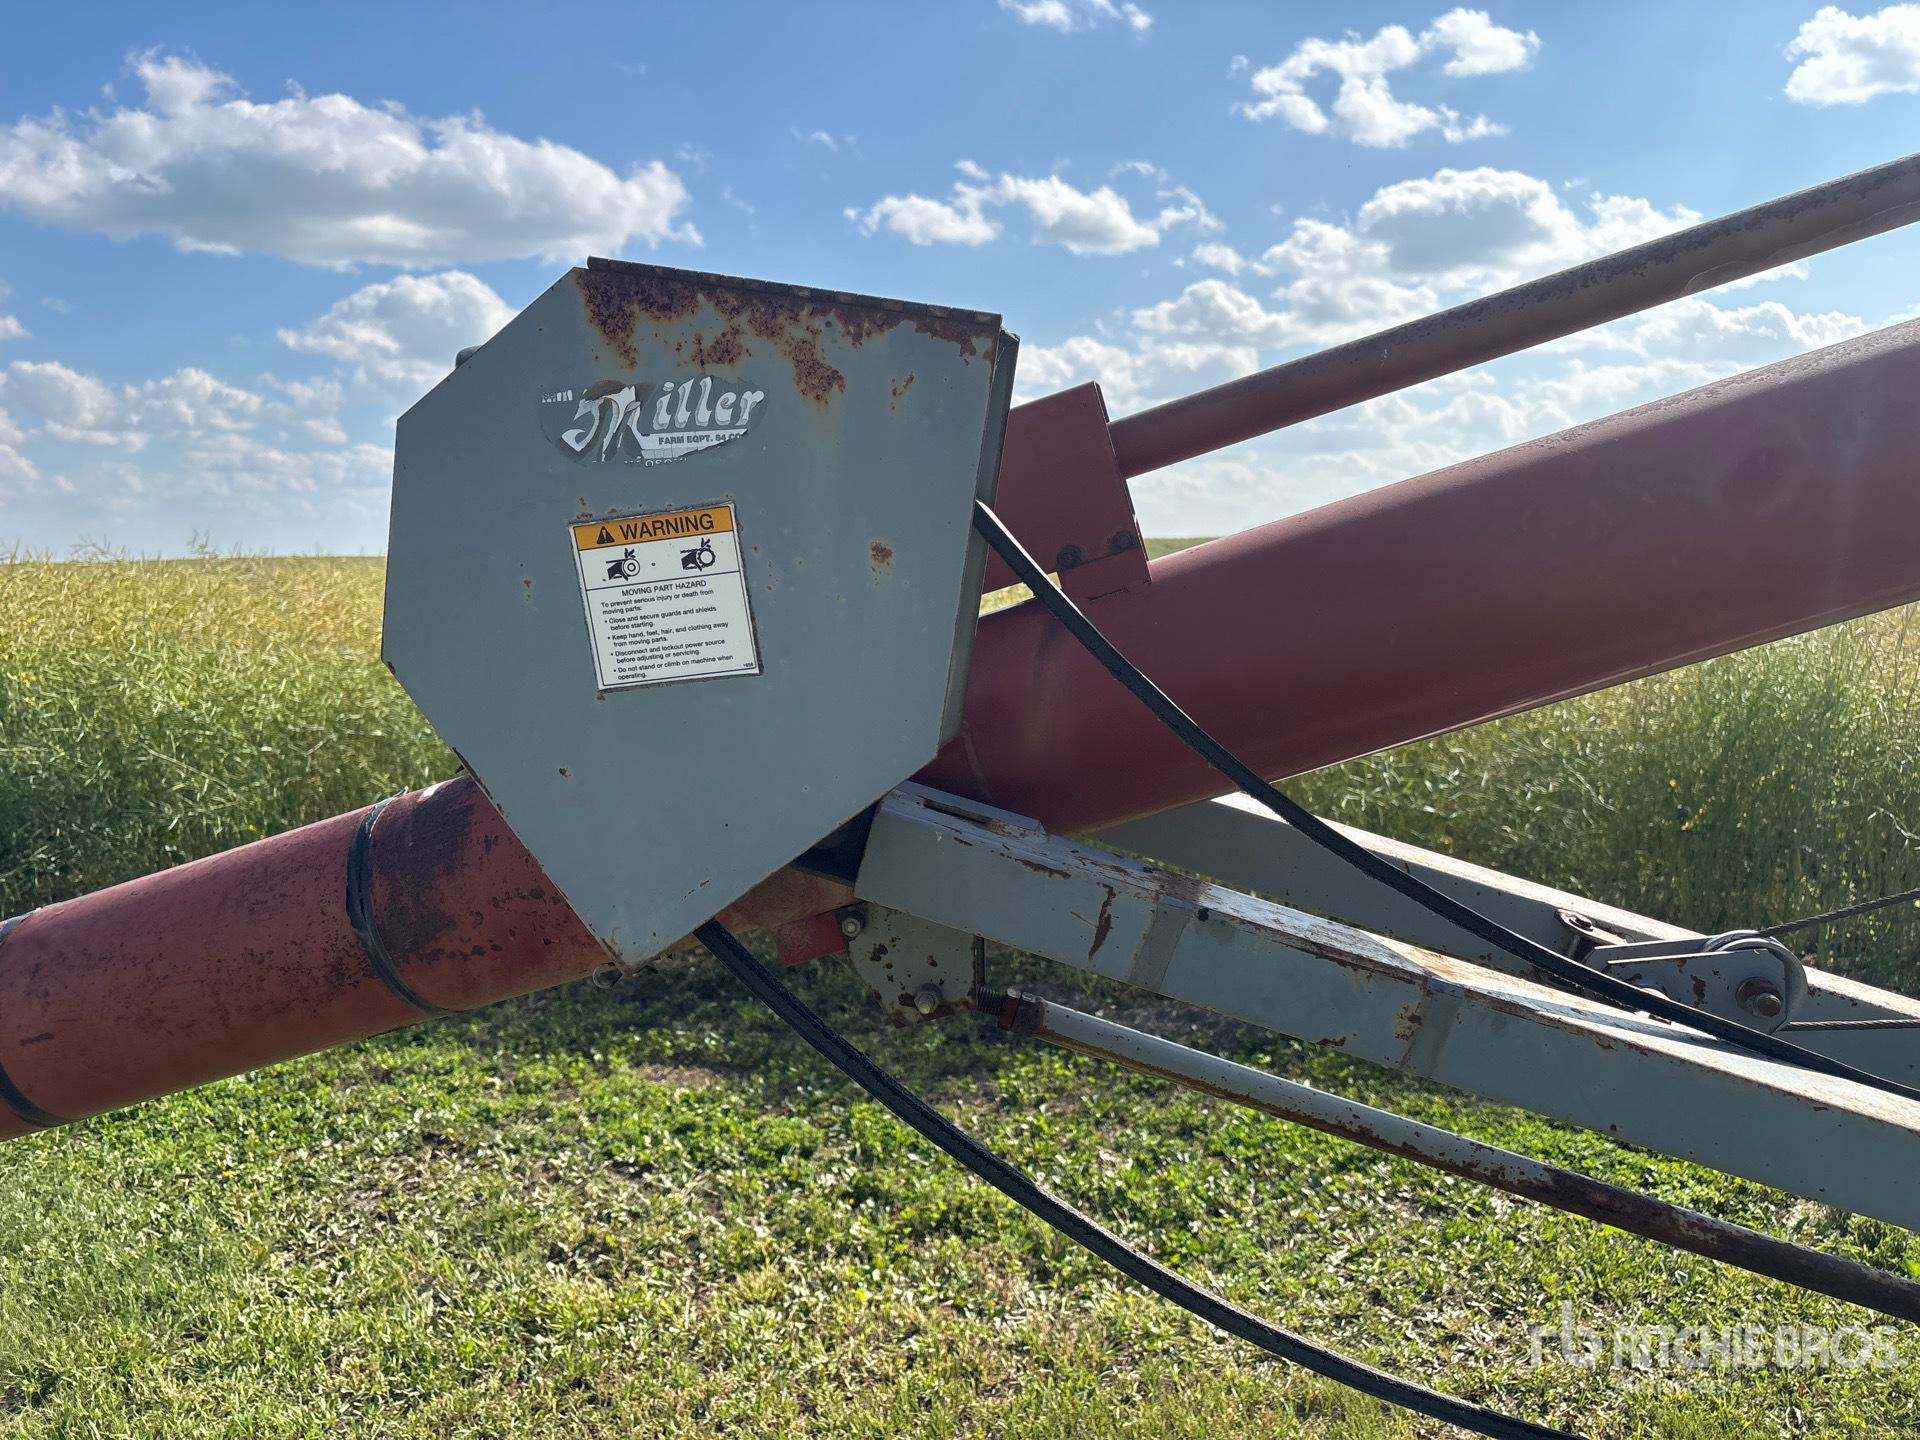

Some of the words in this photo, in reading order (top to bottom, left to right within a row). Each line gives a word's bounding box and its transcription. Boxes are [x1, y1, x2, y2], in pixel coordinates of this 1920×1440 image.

[659, 437, 684, 445] FARM
[687, 435, 713, 443] EQPT.
[619, 513, 714, 541] WARNING
[622, 586, 652, 597] MOVING
[654, 584, 673, 592] PART
[675, 580, 707, 590] HAZARD
[610, 598, 632, 607] prevent
[656, 594, 673, 602] injury
[625, 605, 642, 613] parts:
[640, 613, 659, 621] secure
[661, 610, 681, 619] guards
[631, 621, 655, 629] starting.
[629, 631, 645, 639] hand,
[688, 623, 712, 631] clothing
[629, 638, 650, 646] moving
[615, 649, 648, 657] Disconnect
[662, 643, 684, 652] lockout
[637, 653, 664, 662] adjusting
[673, 649, 701, 657] servicing.
[691, 656, 716, 664] machine
[617, 672, 647, 680] operating.
